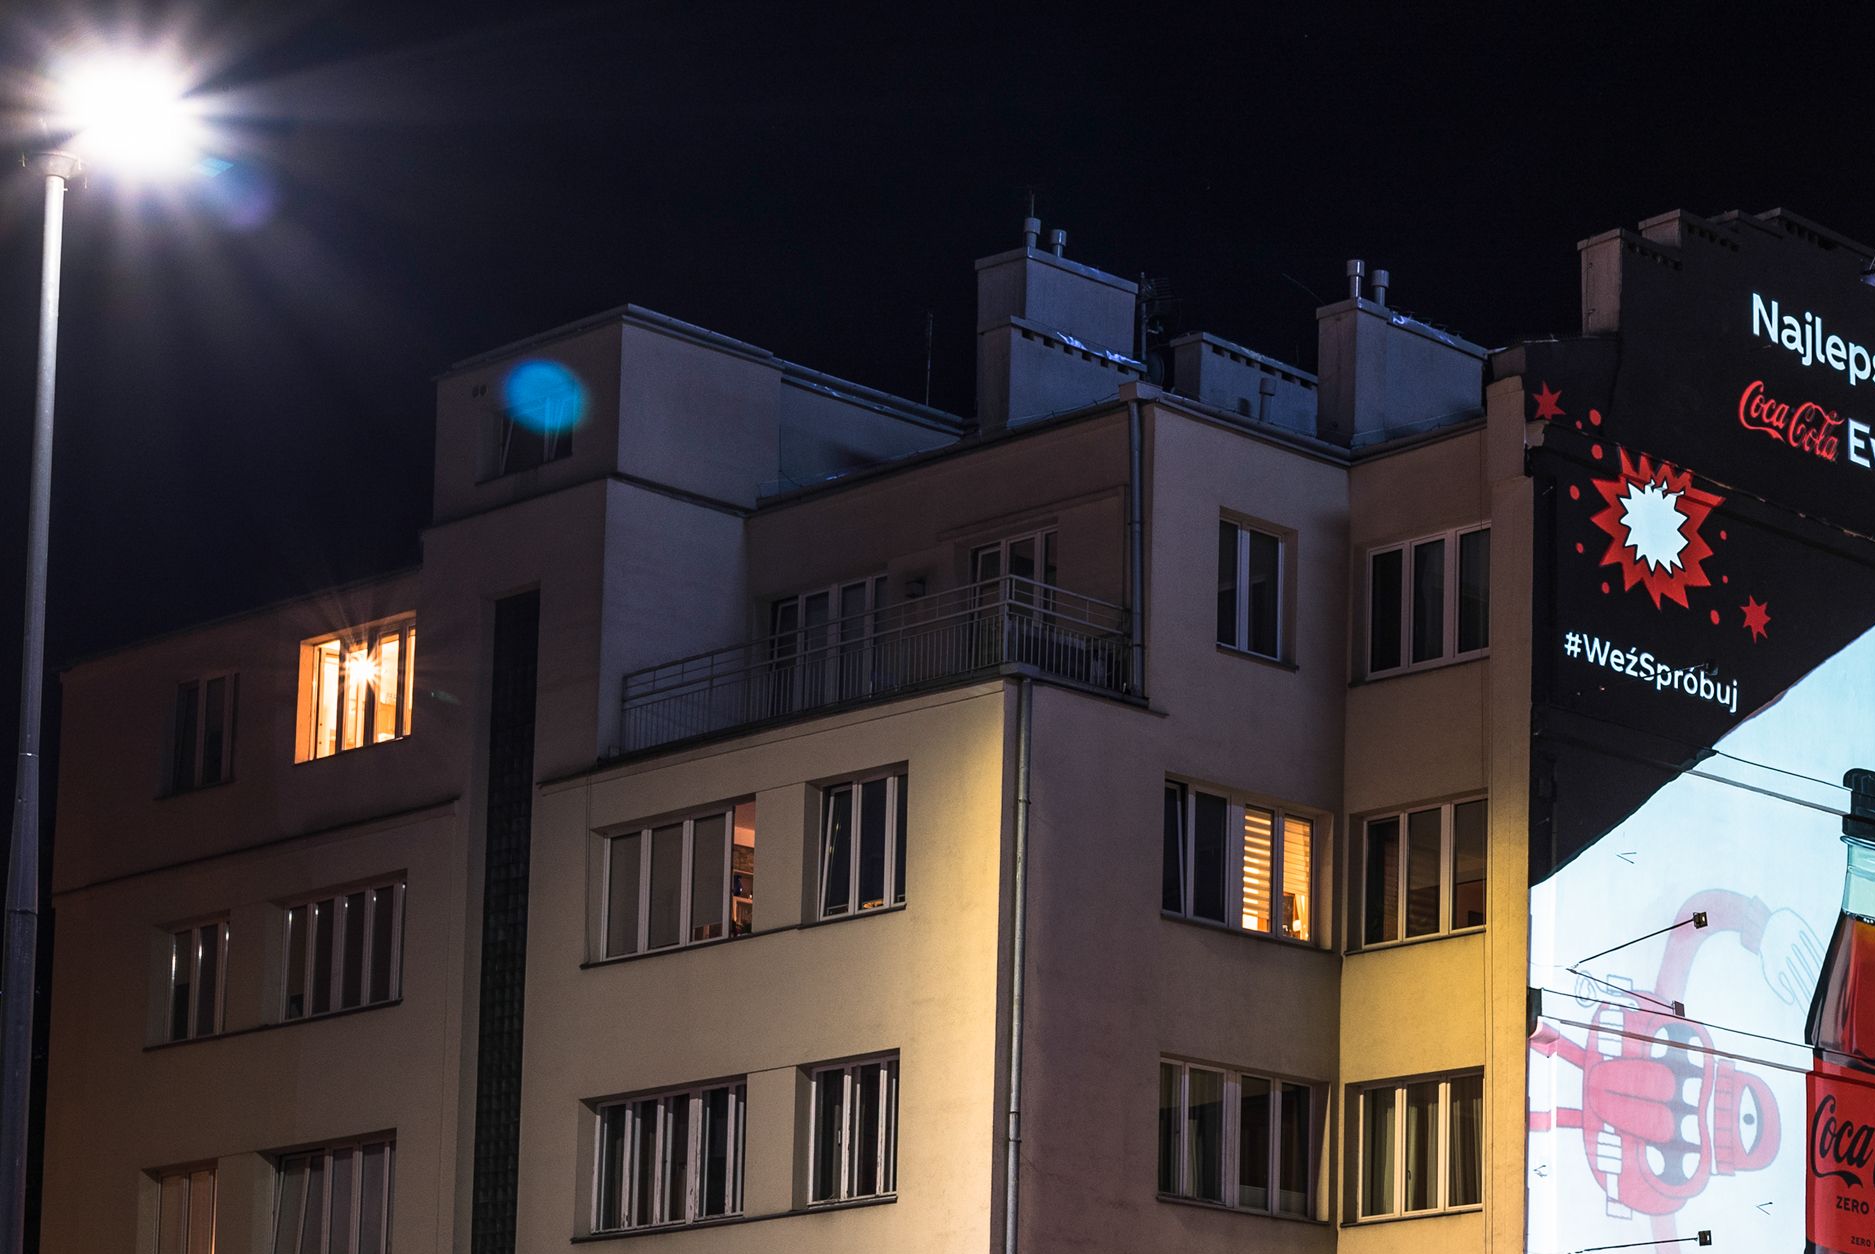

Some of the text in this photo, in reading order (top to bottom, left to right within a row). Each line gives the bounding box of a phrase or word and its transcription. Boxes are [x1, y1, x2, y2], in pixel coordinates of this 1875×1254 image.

[1564, 631, 1738, 714] #WeźSpróbuj
[1836, 1195, 1870, 1215] ZERO
[1850, 1235, 1871, 1248] ZERO
